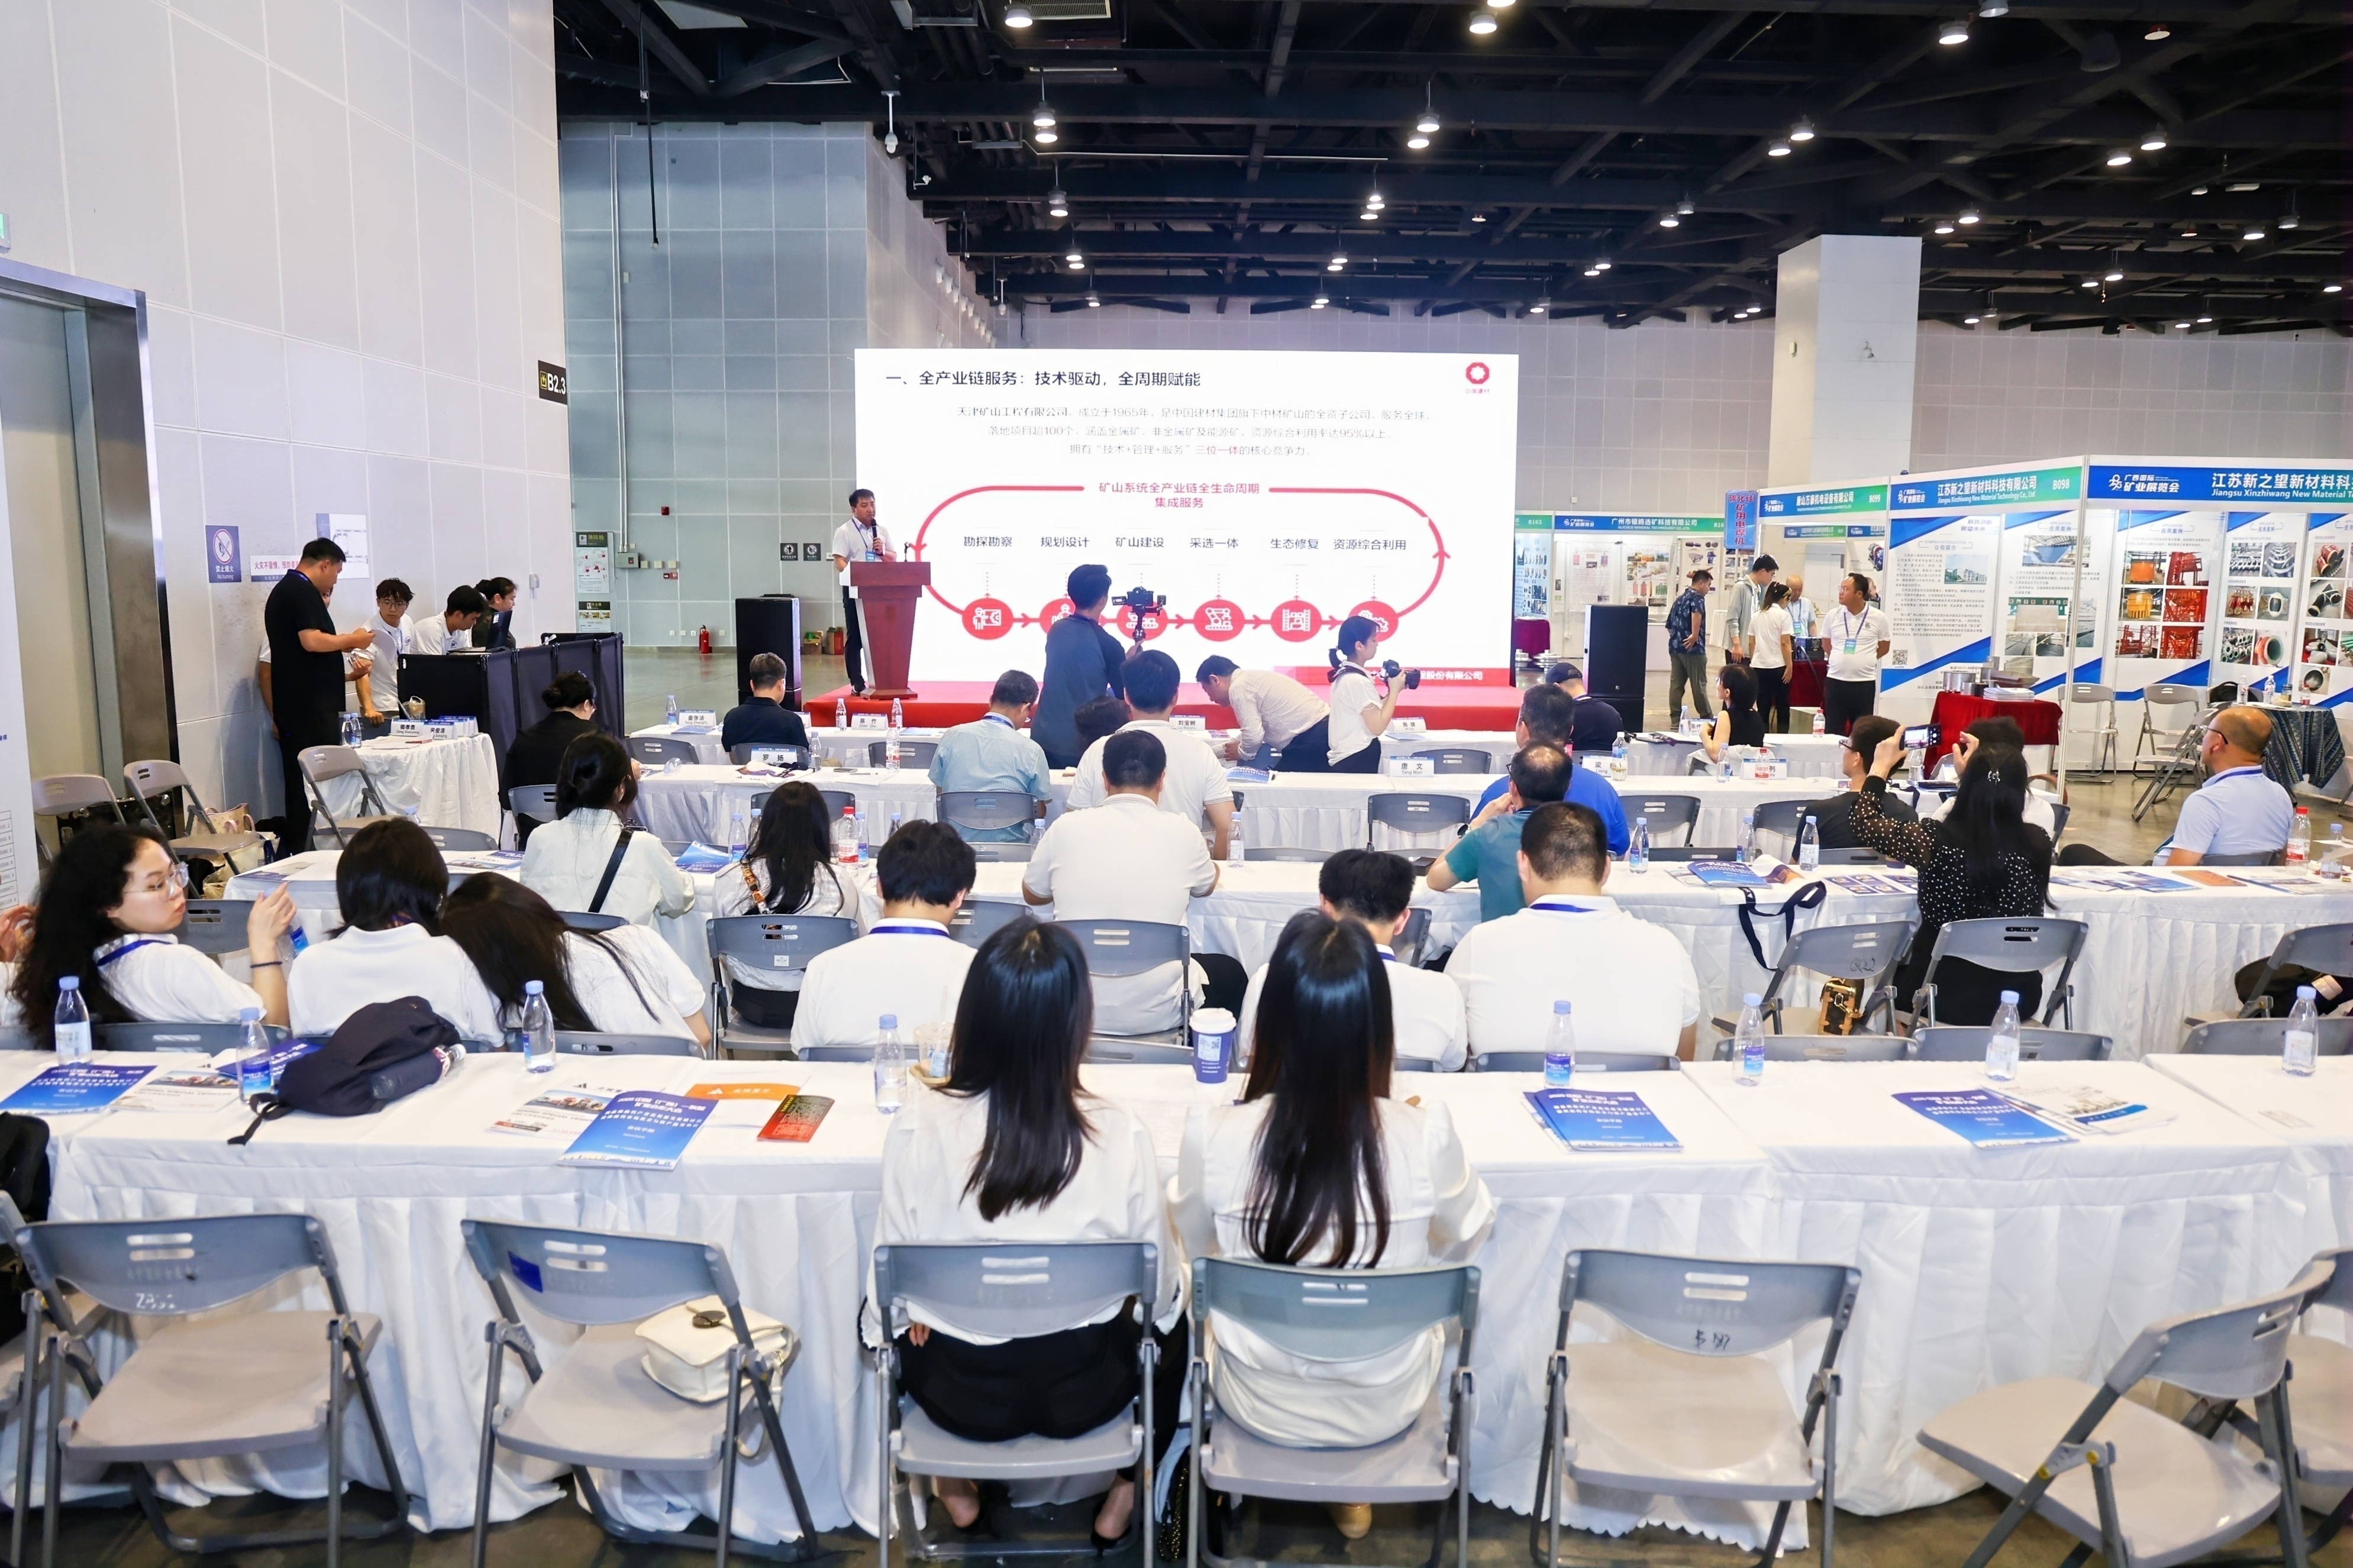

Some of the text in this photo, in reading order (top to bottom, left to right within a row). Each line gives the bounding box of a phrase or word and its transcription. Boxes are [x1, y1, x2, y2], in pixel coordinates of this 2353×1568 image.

[547, 373, 566, 395] B2.3
[885, 370, 1201, 387] 一、全产业链服务：技术驱动，全周期赋能
[1938, 475, 2037, 496] 江苏新之望新材料科技有限公司
[2052, 479, 2070, 490] B098
[2123, 482, 2180, 493] 矿业展览会
[2212, 473, 2353, 490] 江苏新之望新材料科
[1099, 482, 1260, 494] 矿山系统全产业链全生命周期
[2212, 489, 2242, 498] Jiangsu
[2244, 489, 2290, 499] Xinzhiwang
[1154, 497, 1204, 509] 集成服务
[1869, 494, 1881, 503] B099
[1734, 504, 1747, 545] 矿用电焊机
[963, 536, 1013, 548] 勘探勘察
[1040, 536, 1090, 548] 规划设计
[1115, 537, 1164, 548] 矿山建设
[1189, 537, 1239, 549] 采选一体
[1270, 538, 1319, 549] 生态修复
[1333, 539, 1407, 550] 资源综合利用
